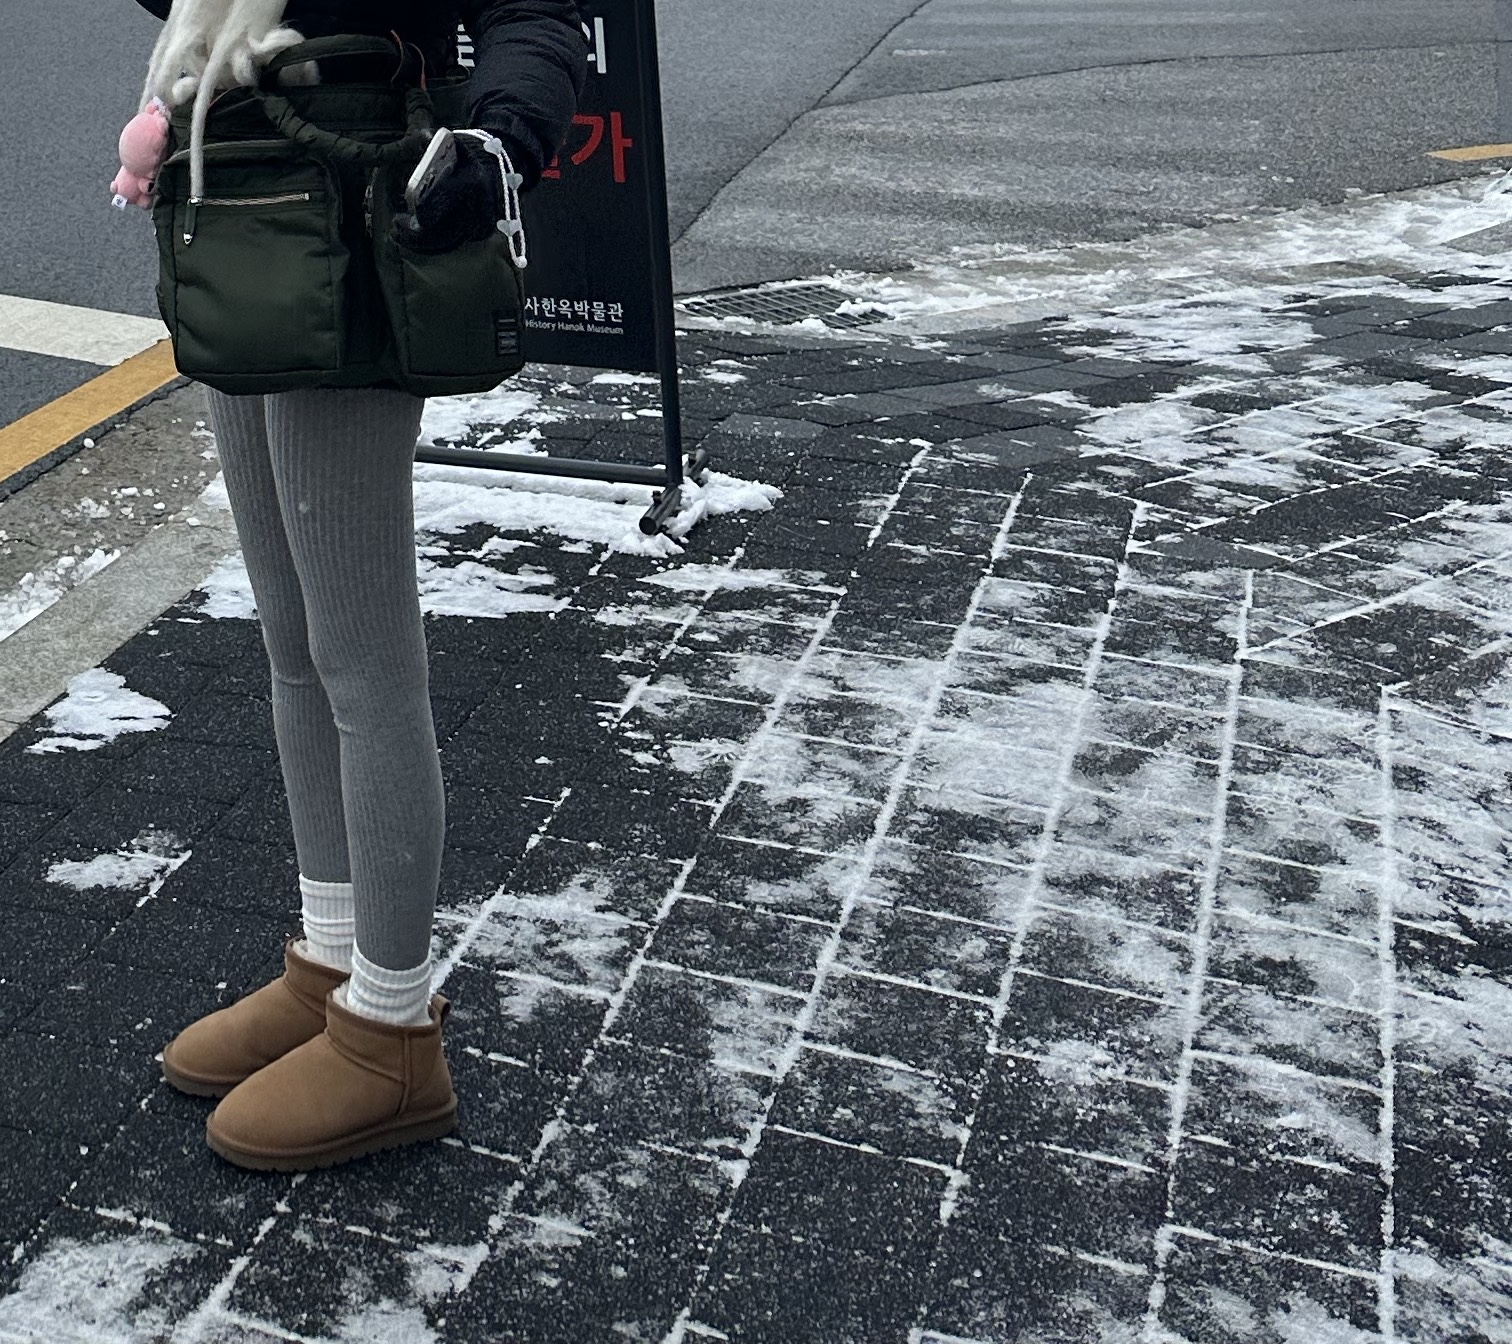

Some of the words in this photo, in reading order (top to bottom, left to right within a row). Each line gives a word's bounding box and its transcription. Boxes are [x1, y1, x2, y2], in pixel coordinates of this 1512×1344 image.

[525, 319, 557, 331] History
[557, 321, 586, 332] Hanok
[587, 323, 624, 335] Museum
